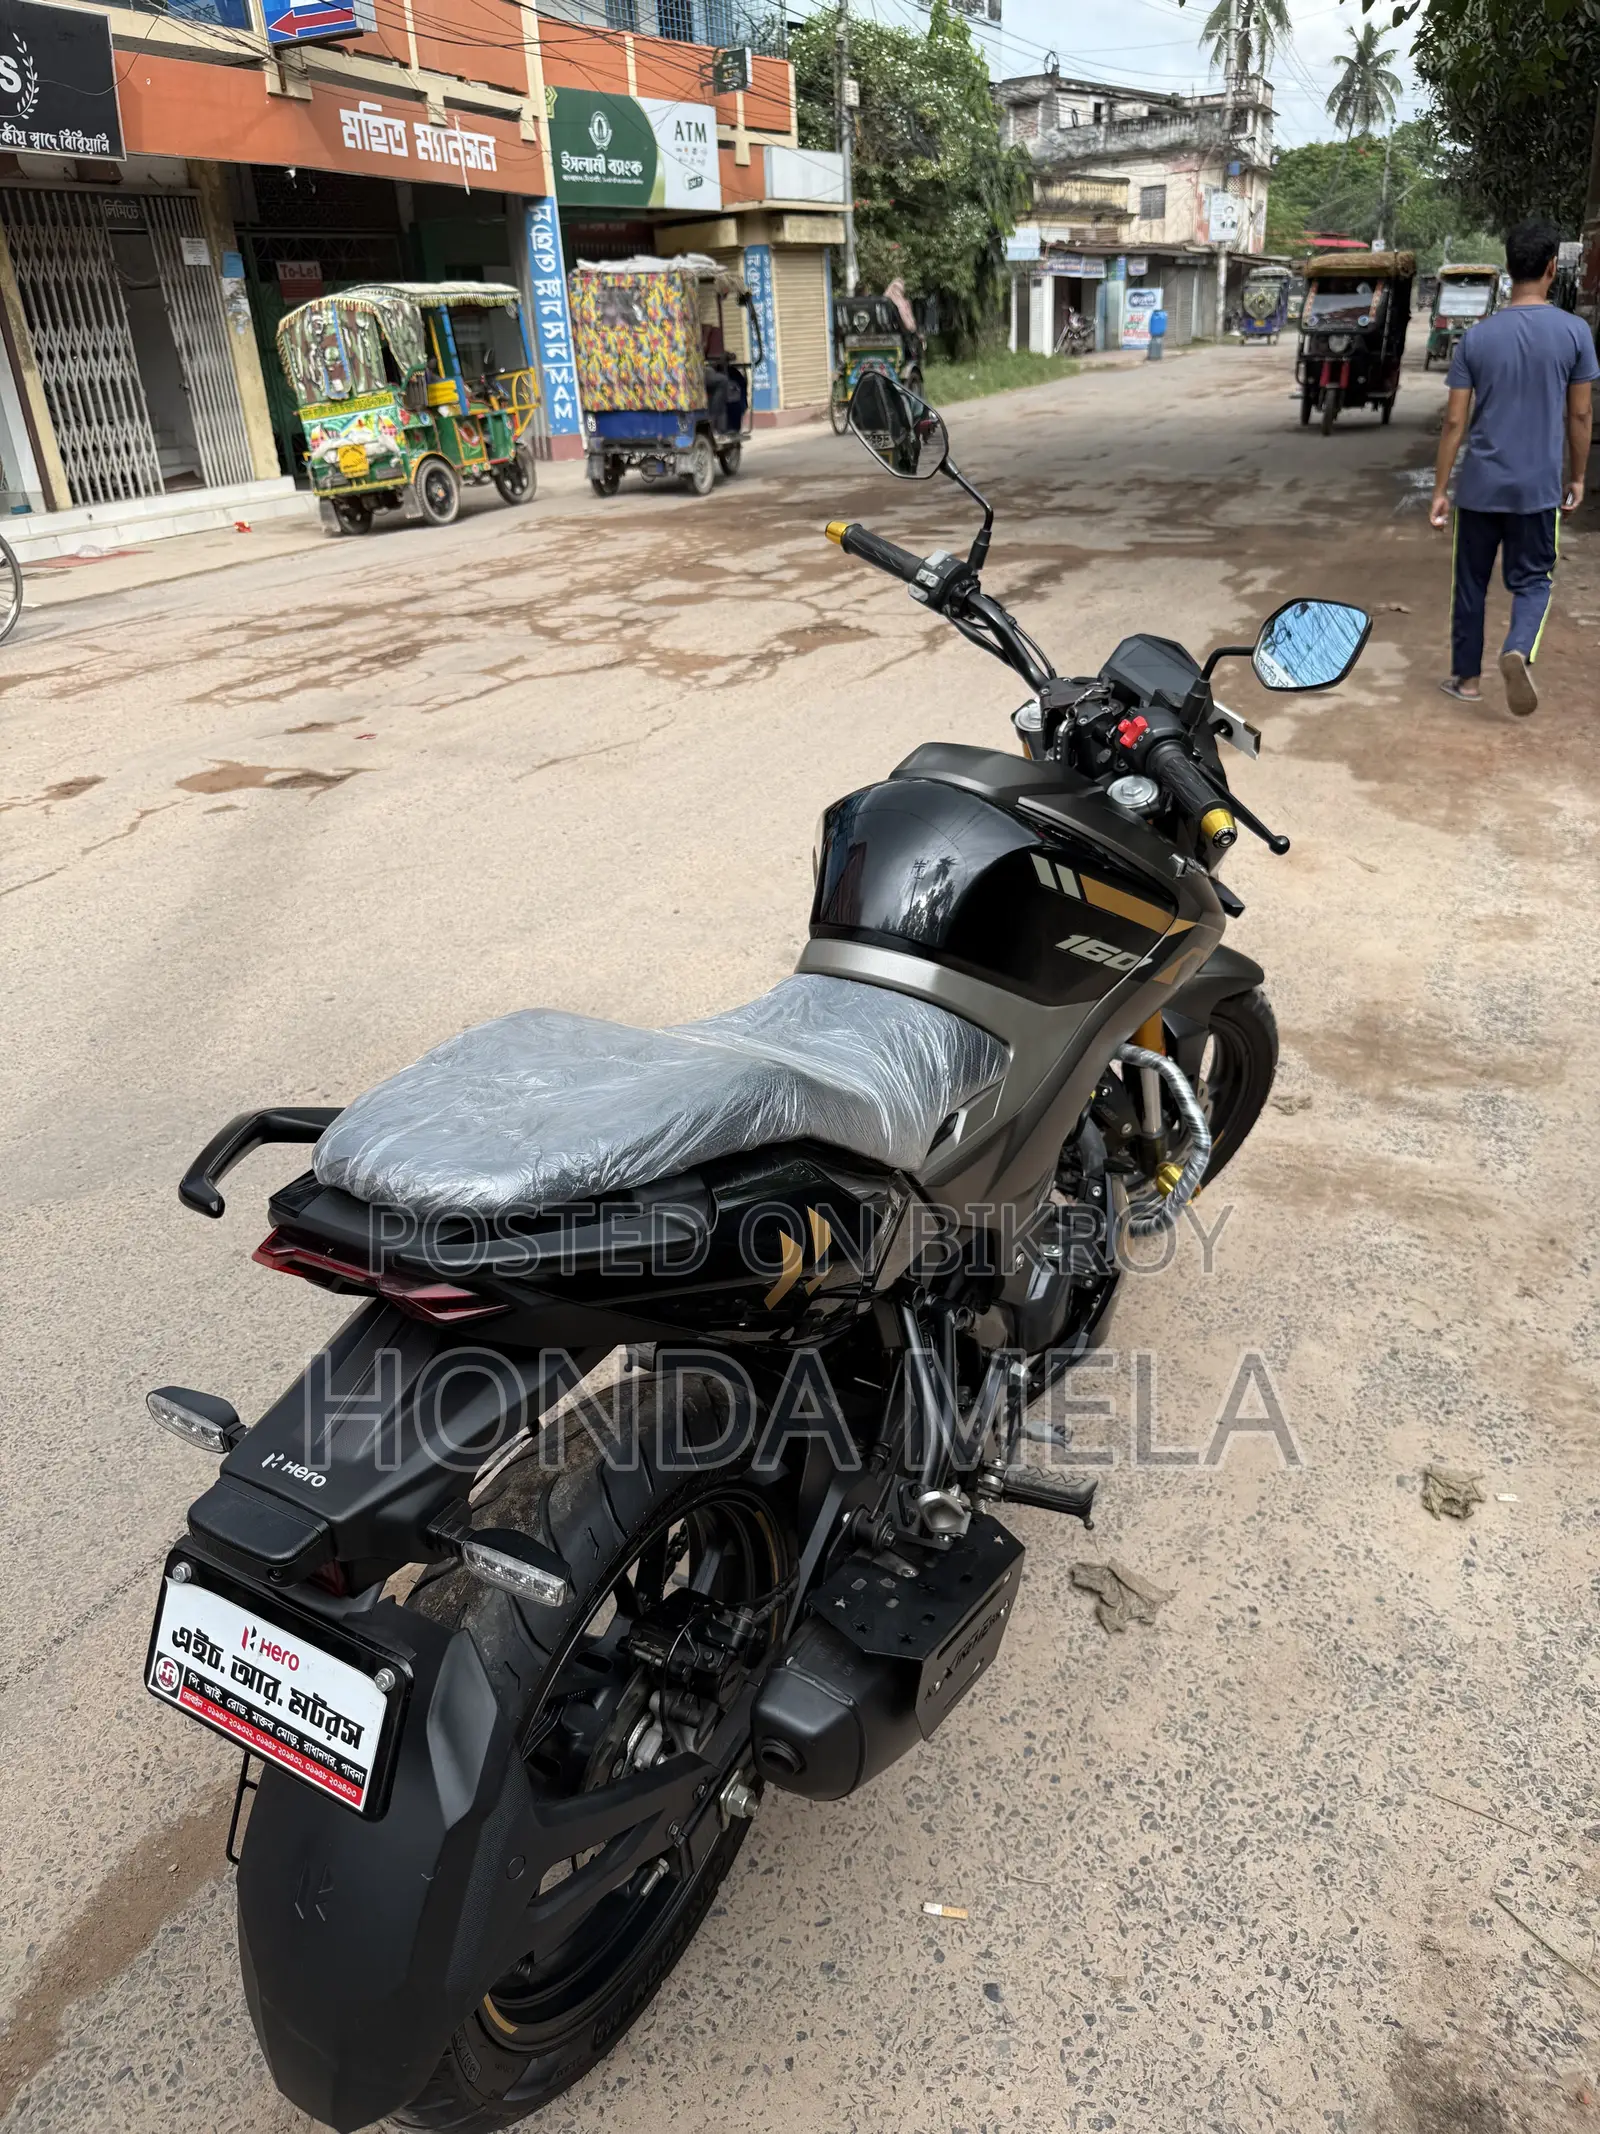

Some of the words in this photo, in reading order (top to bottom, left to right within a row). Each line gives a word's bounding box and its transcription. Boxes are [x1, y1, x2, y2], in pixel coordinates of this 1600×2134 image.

[0, 121, 27, 148] কীয়
[28, 131, 60, 151] স্বাদে
[59, 128, 110, 154] বিরিয়ানি
[674, 120, 707, 143] ATM
[560, 151, 606, 174] ইসলামী
[607, 158, 643, 177] ব্যাংক
[102, 199, 147, 219] লিমিটে
[1054, 934, 1153, 972] 160
[281, 1460, 327, 1487] Hero
[260, 1637, 299, 1672] Hero
[231, 1655, 283, 1706] আর.
[288, 1687, 365, 1750] মটরস
[341, 1763, 365, 1784] পাবনা
